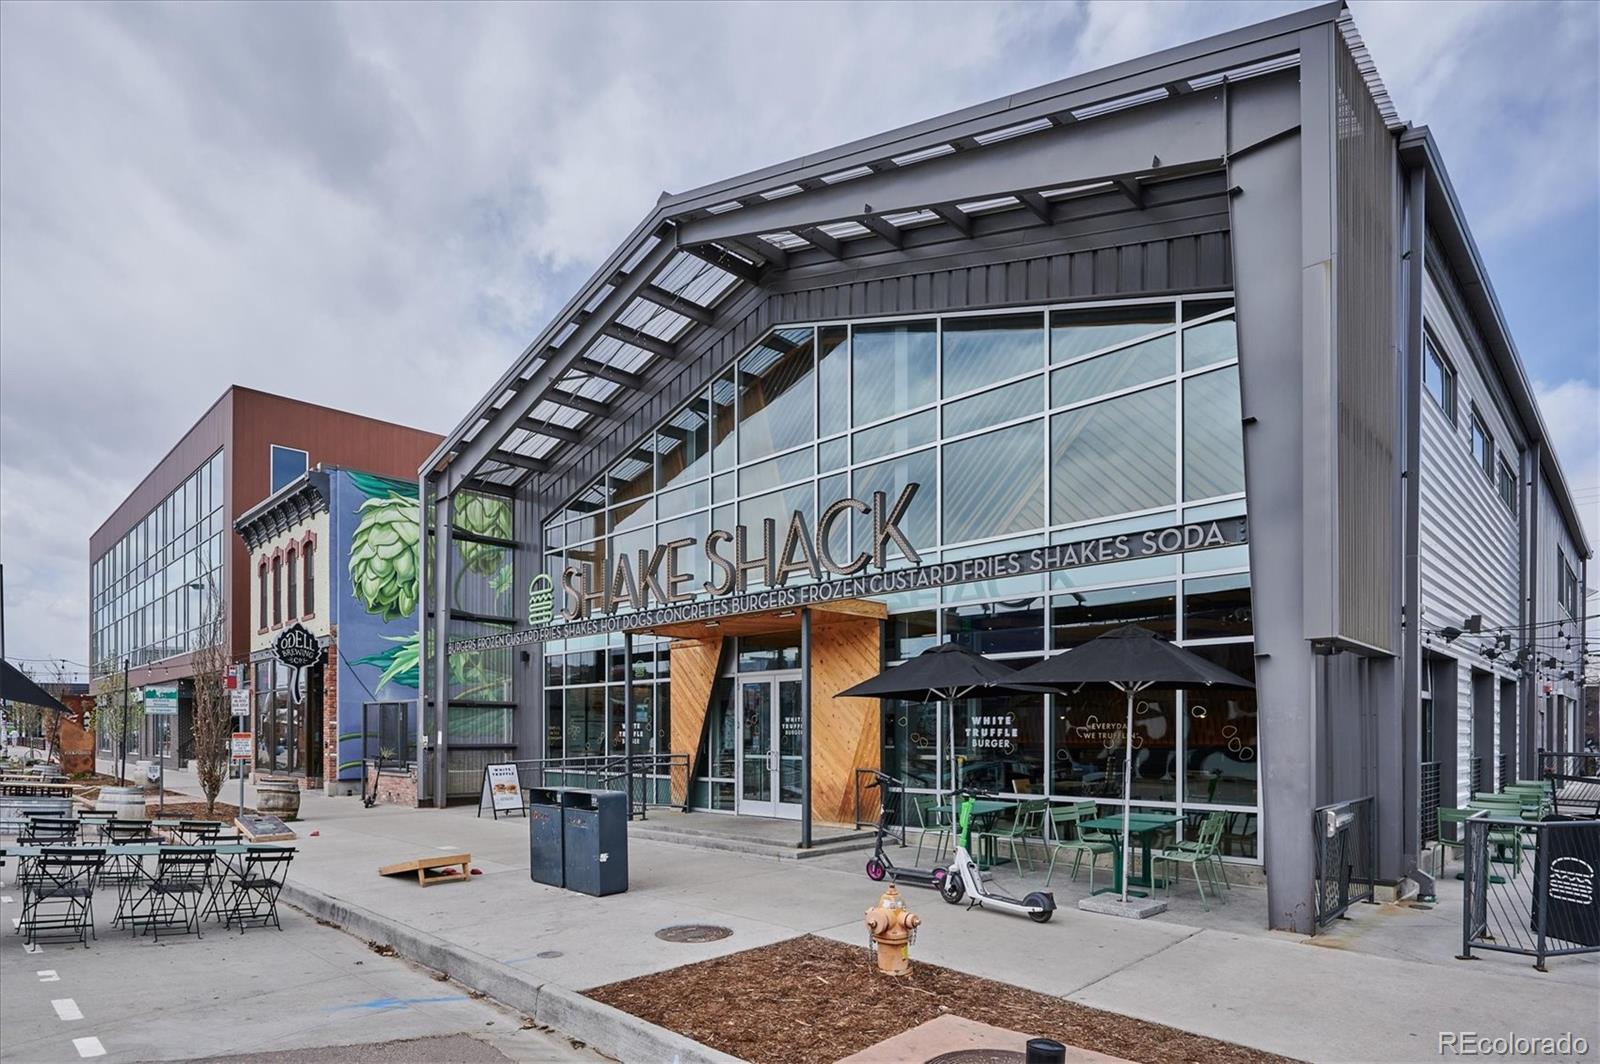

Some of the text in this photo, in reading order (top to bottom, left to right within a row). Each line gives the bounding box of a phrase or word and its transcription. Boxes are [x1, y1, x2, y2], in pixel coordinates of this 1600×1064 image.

[562, 483, 923, 622] SHAKE SHACK
[477, 634, 504, 650] FROZEN
[505, 628, 539, 646] CUSTARD
[540, 625, 561, 641] FRIES
[564, 620, 598, 638] SHAKES
[600, 616, 621, 632] HOT
[622, 611, 652, 630] DOGS
[655, 599, 729, 624] CONCRETES
[731, 587, 796, 614] BURGERS
[800, 578, 866, 604] FROZEN
[869, 563, 958, 593] CUSTARD
[961, 553, 1020, 580] FRIES
[1029, 535, 1131, 571] SHAKES
[1141, 521, 1225, 554] SODA
[280, 630, 315, 652] ODELL
[281, 649, 314, 659] BREWING
[971, 716, 1012, 726] WHITE
[1091, 722, 1128, 730] EVERYDA
[965, 728, 1018, 737] TRUFFLE
[972, 739, 1010, 748] BURGER
